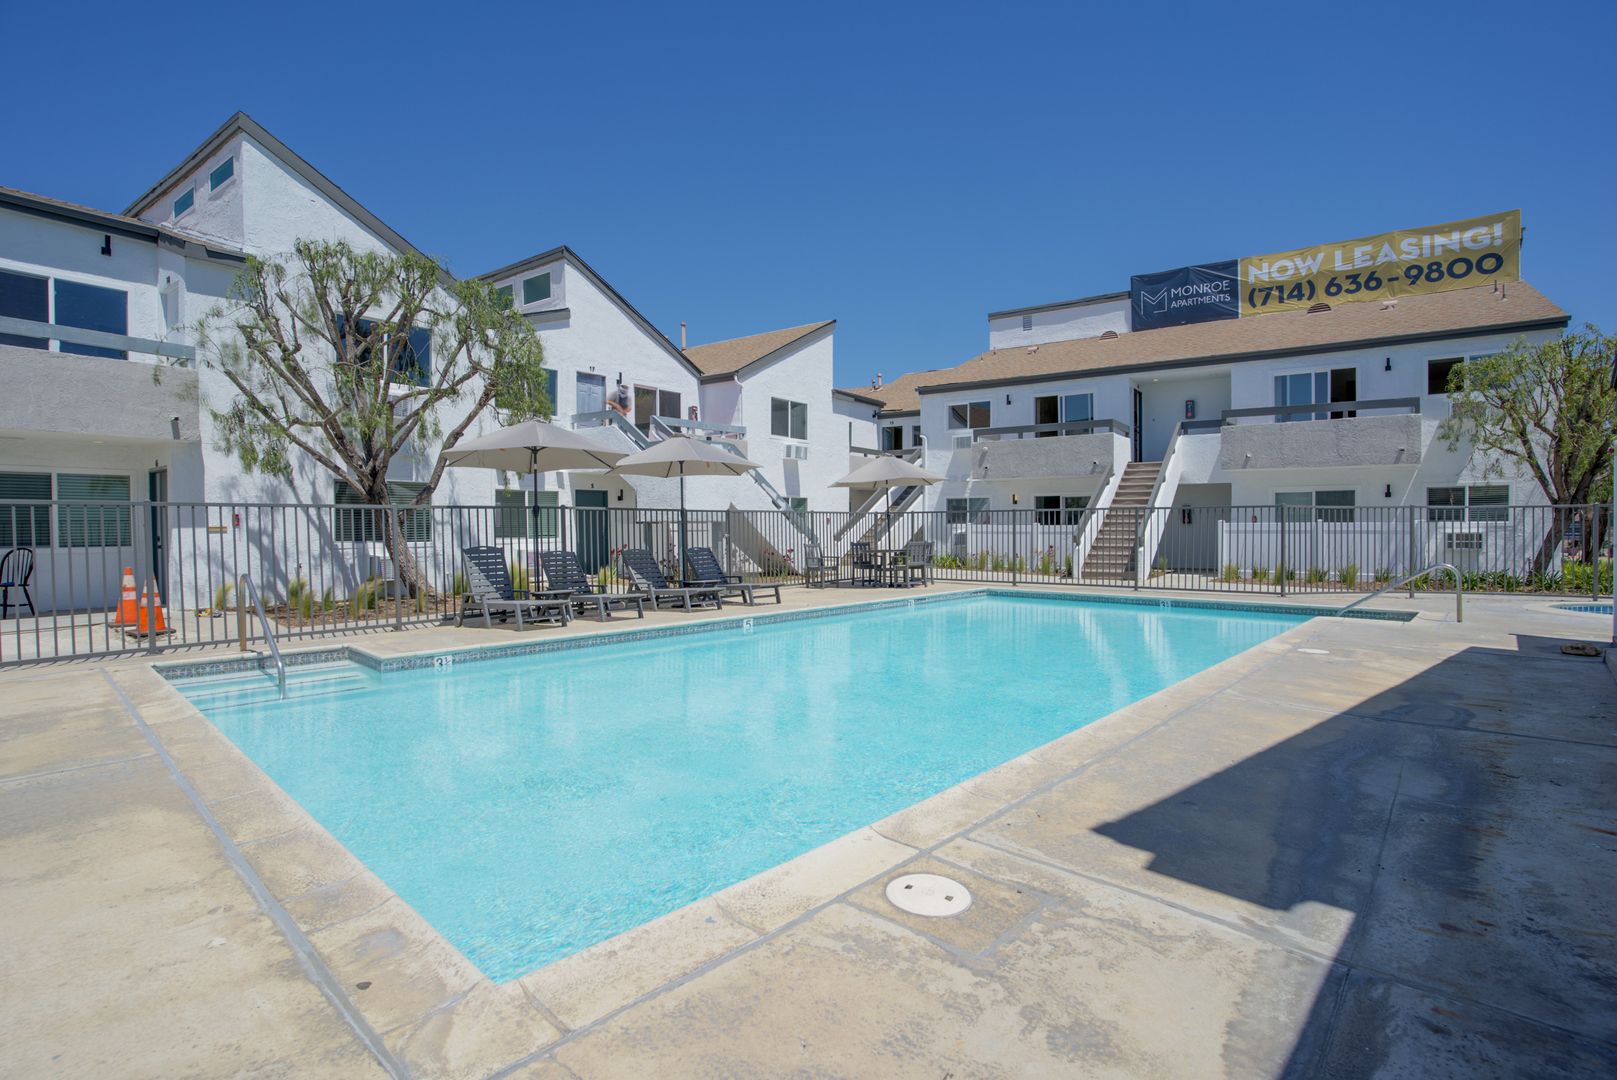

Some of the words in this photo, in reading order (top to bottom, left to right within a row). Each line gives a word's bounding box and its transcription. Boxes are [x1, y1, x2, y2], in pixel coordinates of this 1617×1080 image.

[1247, 252, 1325, 285] NOW
[1334, 222, 1503, 272] LEASING!
[1170, 280, 1231, 298] MONROE
[1248, 279, 1316, 308] (714)
[1324, 252, 1504, 297] 636-9800
[1170, 293, 1231, 309] APARTMENTS
